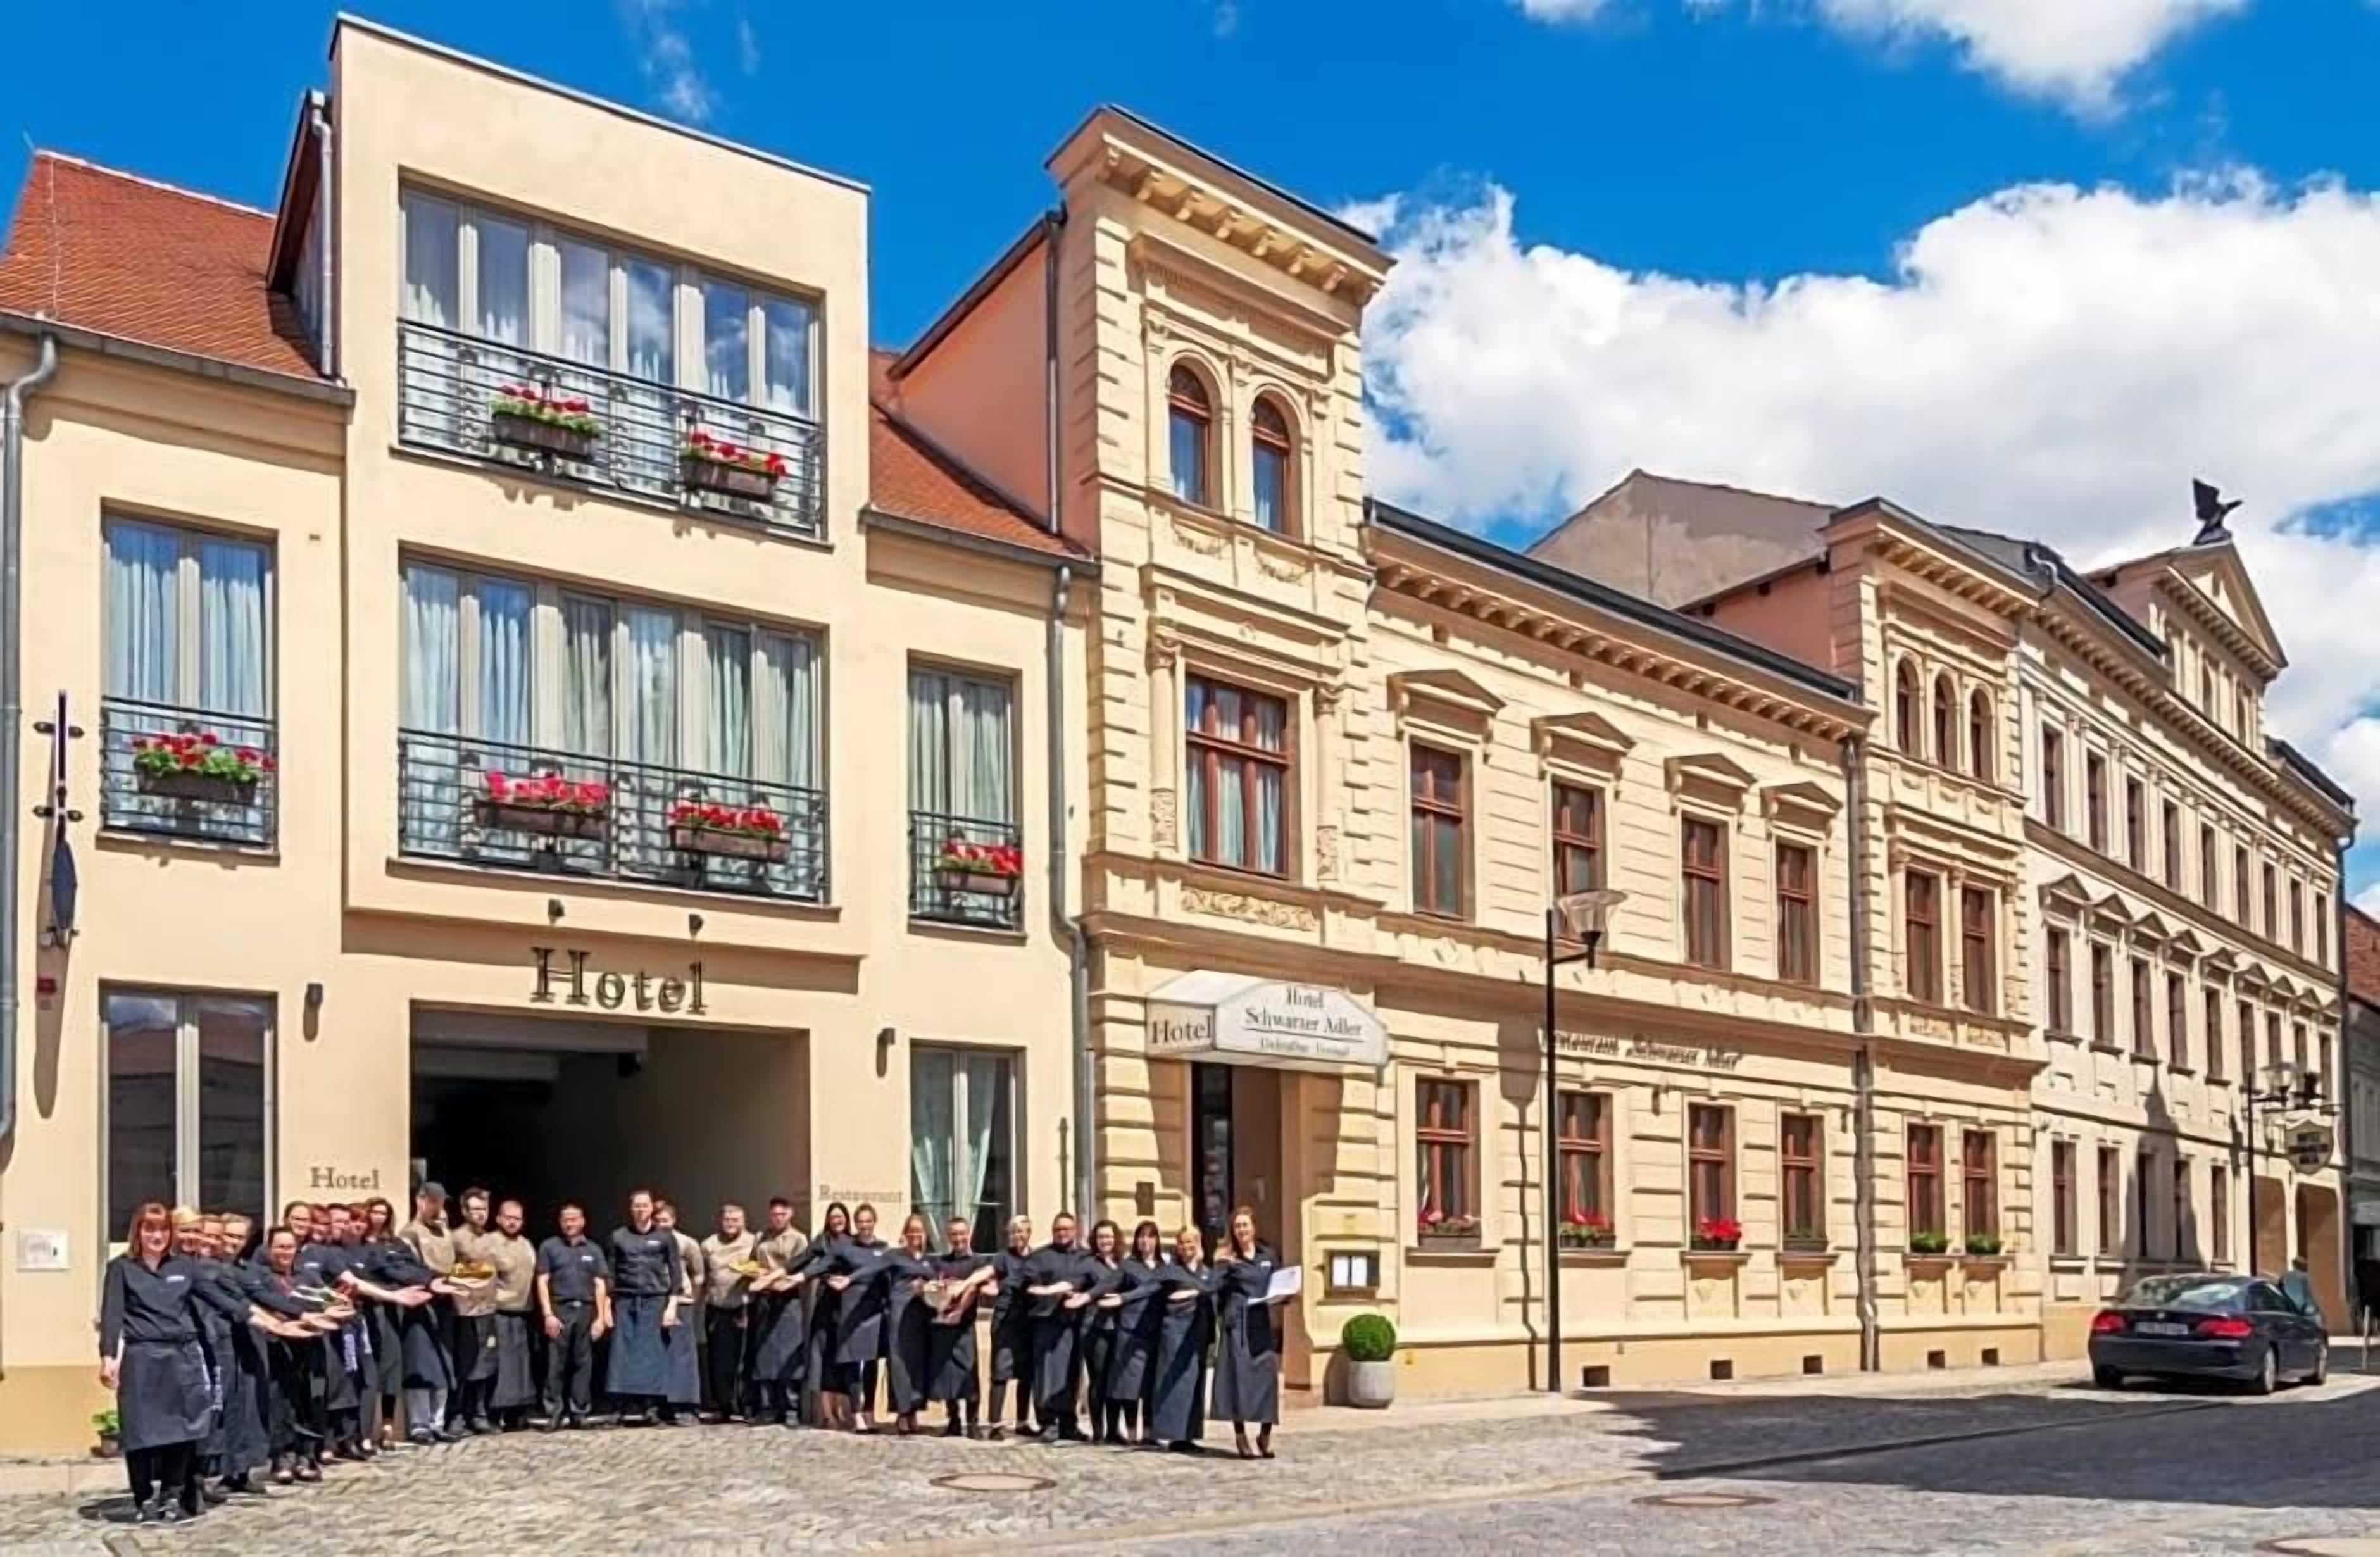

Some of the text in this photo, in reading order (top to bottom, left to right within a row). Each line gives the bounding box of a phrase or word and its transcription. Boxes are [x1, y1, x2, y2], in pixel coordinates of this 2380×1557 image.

[529, 946, 708, 1016] Hotel
[1286, 985, 1324, 1008] Hotel
[1151, 1014, 1212, 1044] Hotel
[1324, 1013, 1362, 1035] Adler
[310, 1166, 380, 1190] Hotel
